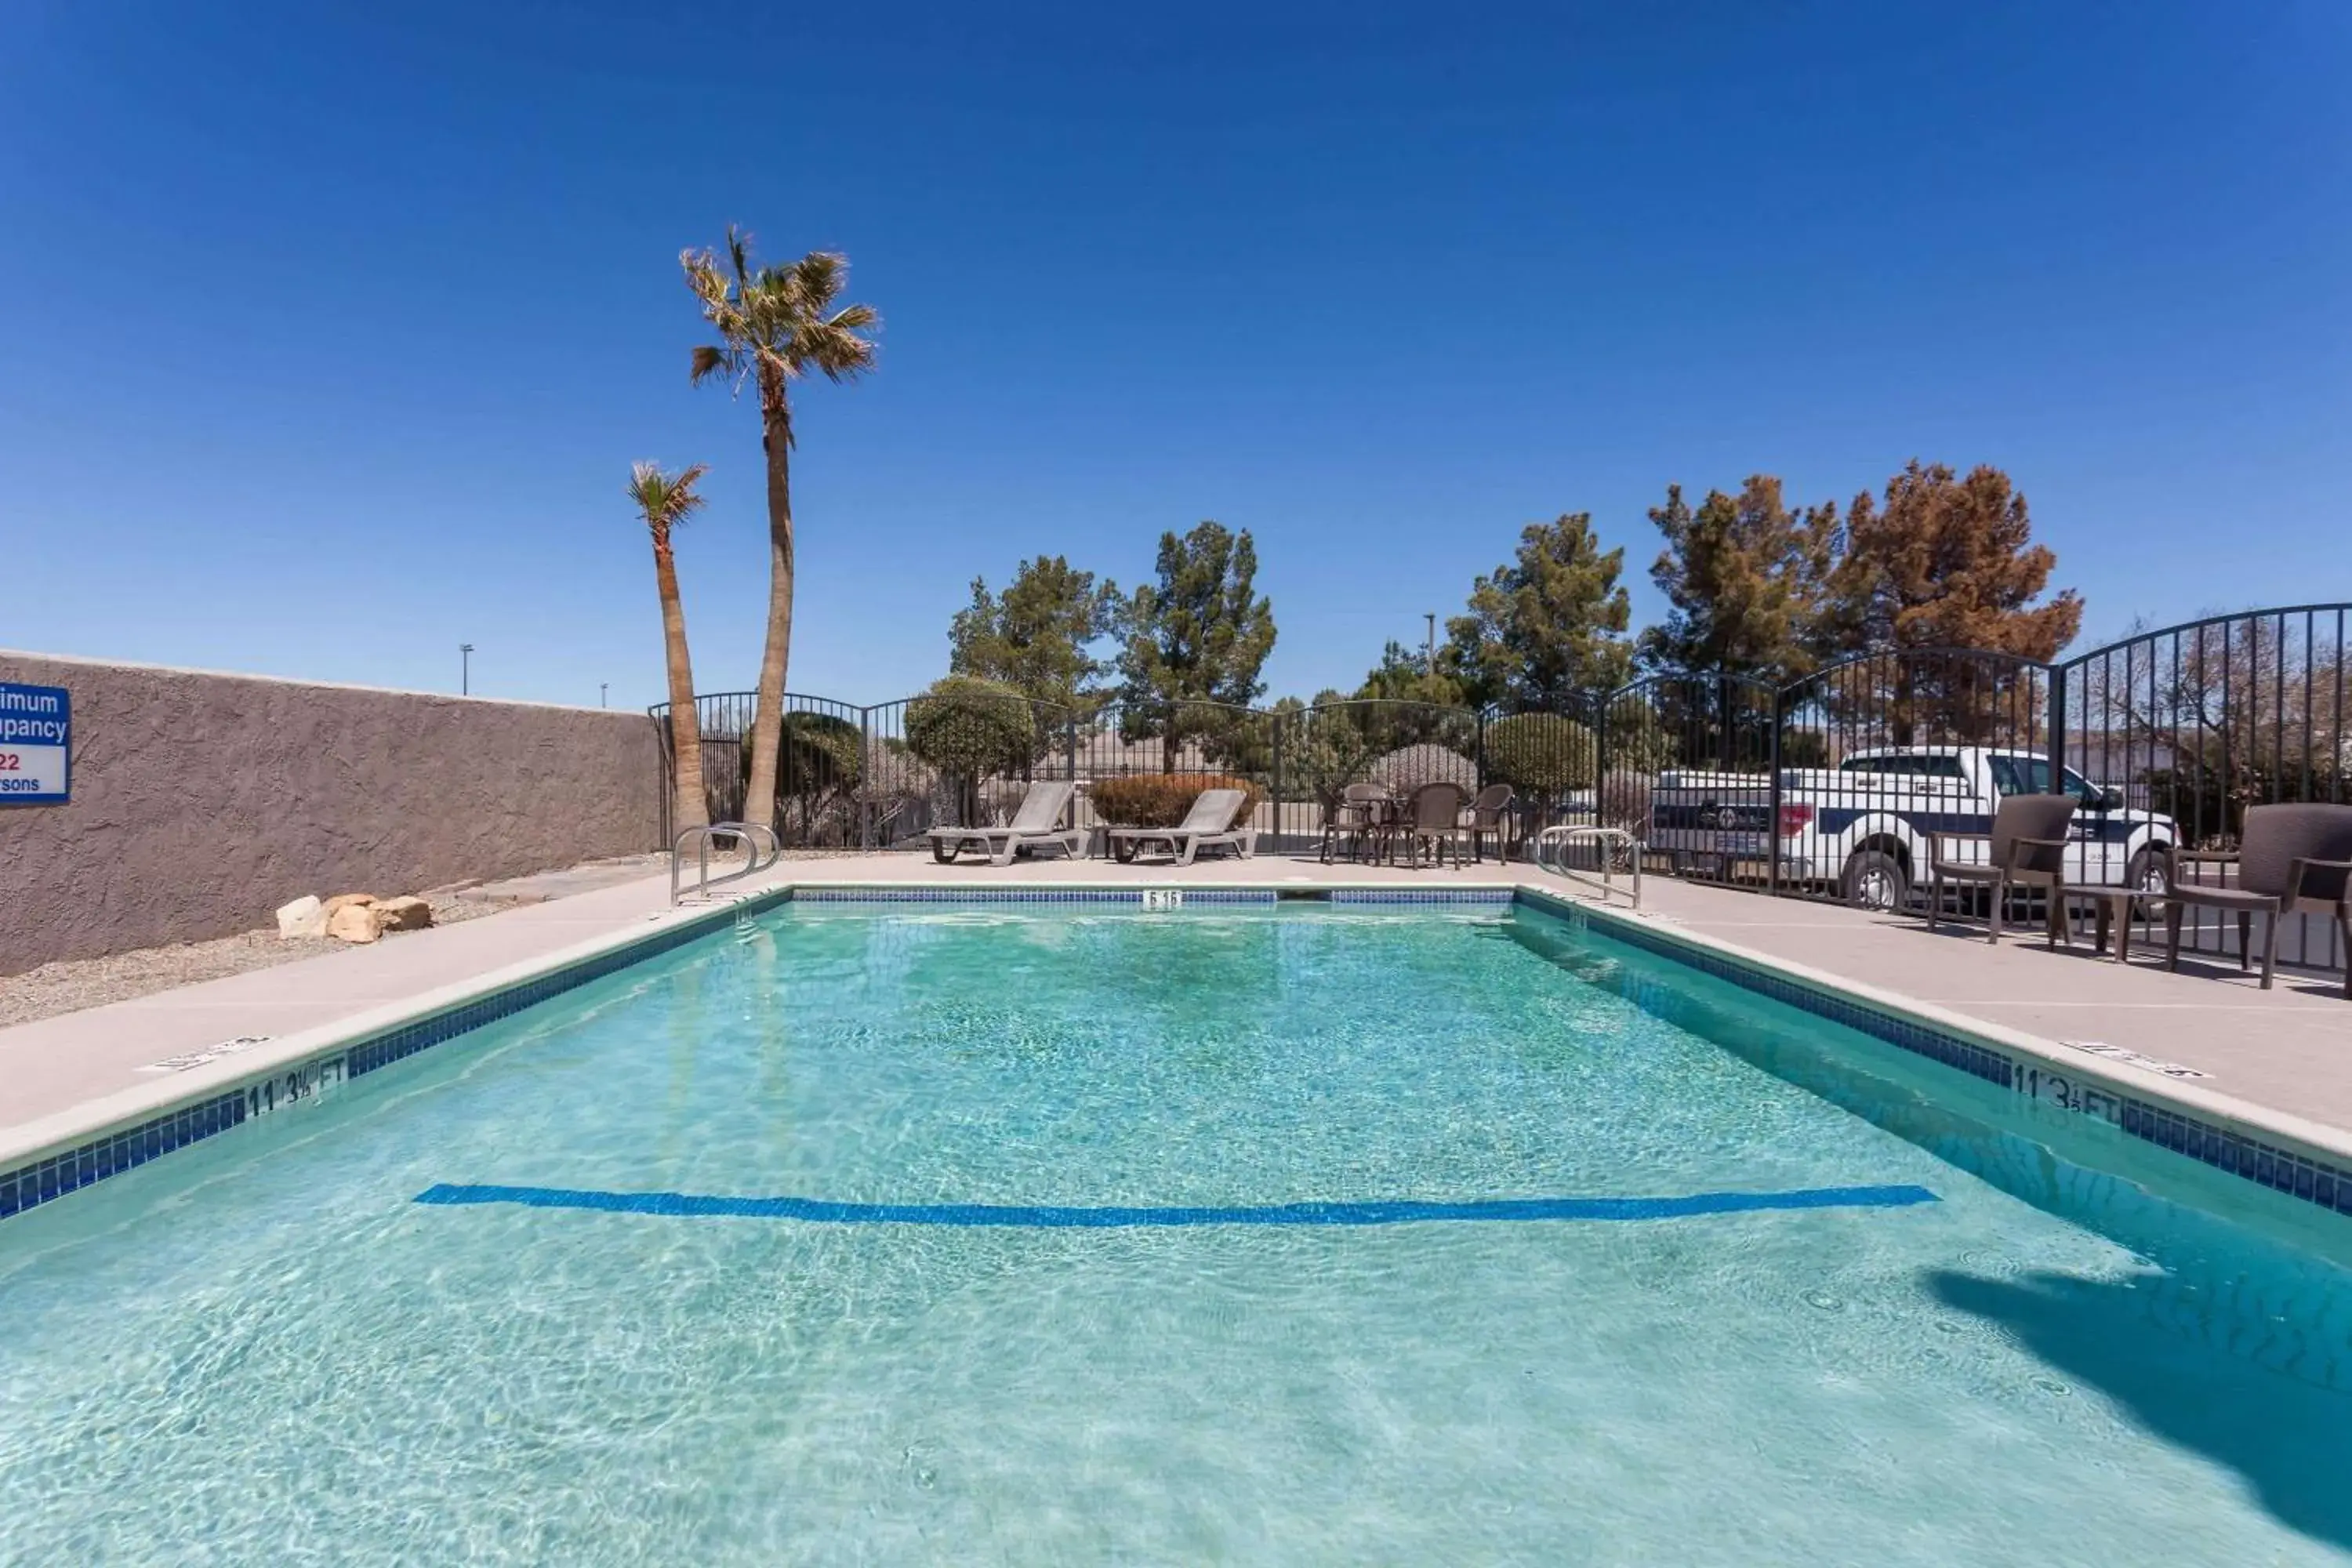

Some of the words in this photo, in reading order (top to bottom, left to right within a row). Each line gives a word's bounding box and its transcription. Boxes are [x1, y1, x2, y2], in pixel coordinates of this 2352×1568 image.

[0, 778, 40, 792] sons
[320, 1058, 344, 1090] FT
[2085, 1089, 2118, 1123] FT
